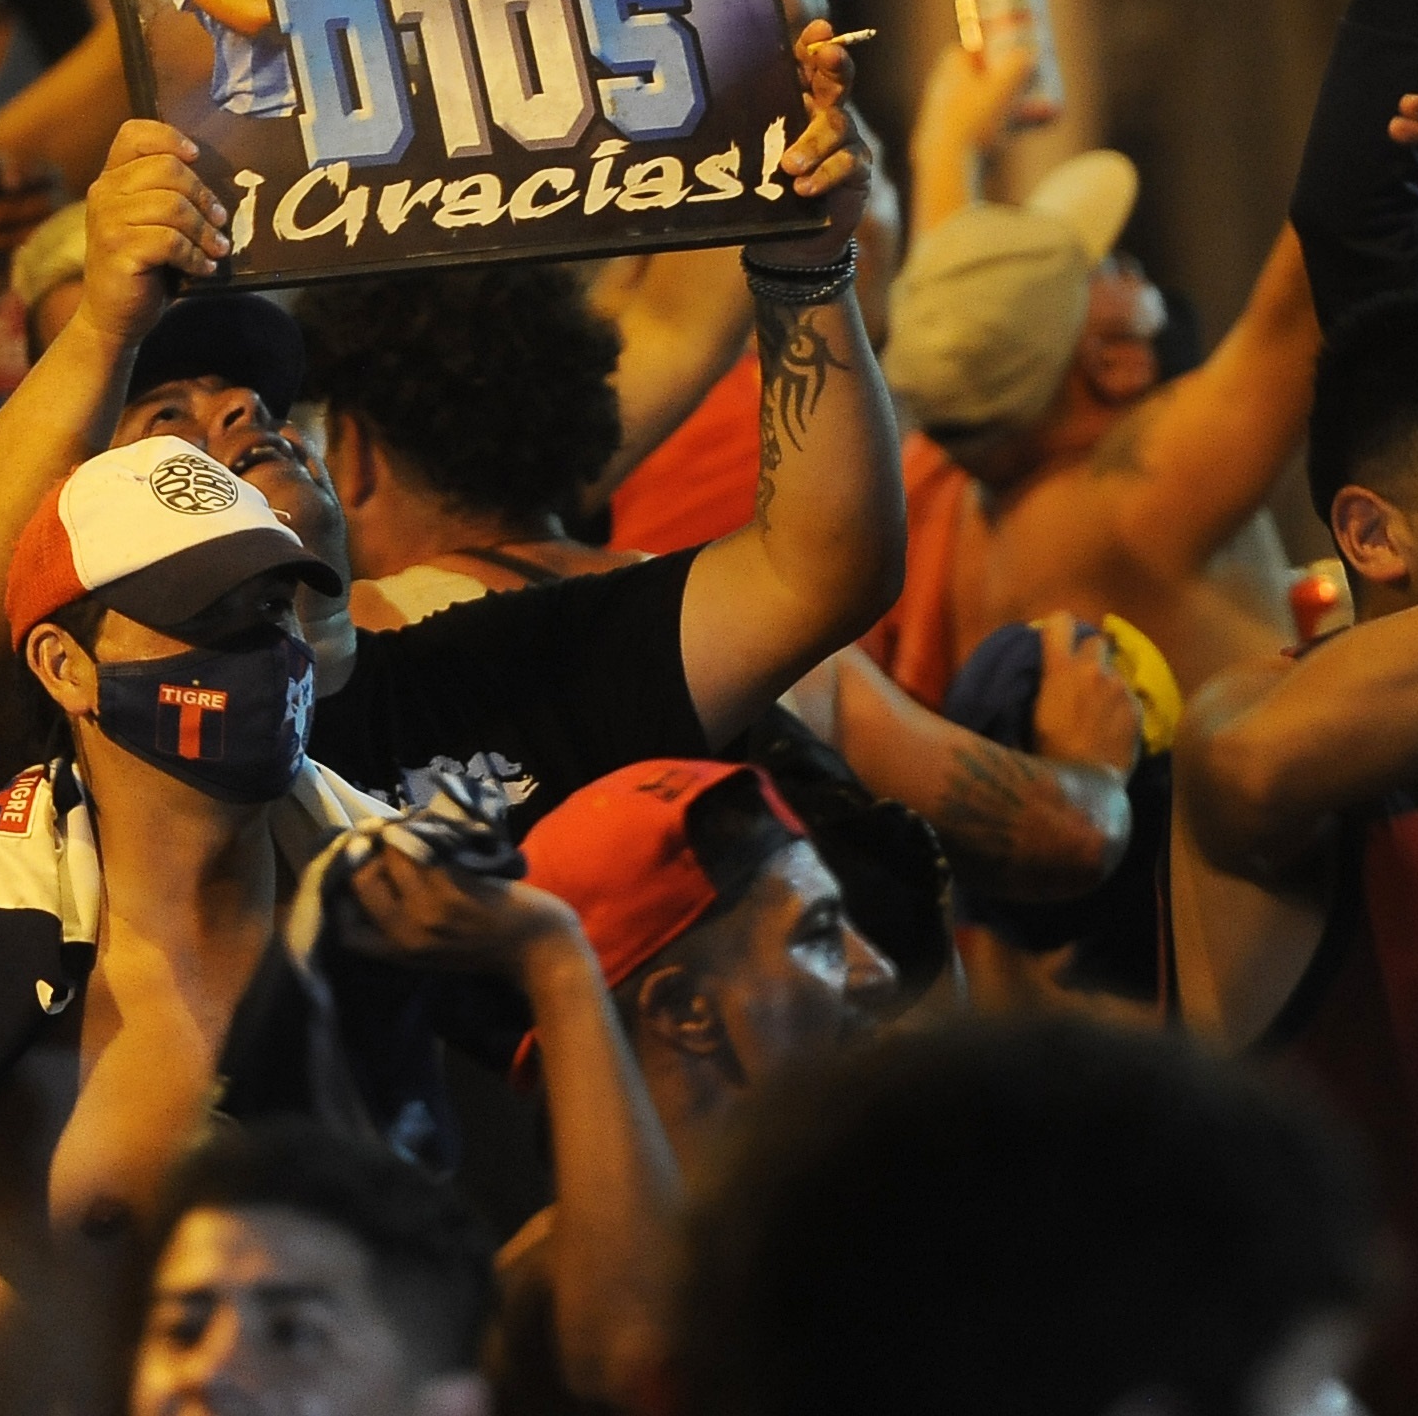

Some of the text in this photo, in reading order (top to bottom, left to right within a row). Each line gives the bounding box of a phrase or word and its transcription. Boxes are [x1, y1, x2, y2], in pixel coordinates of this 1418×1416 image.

[230, 116, 787, 256] ¡Gracias!
[161, 686, 225, 709] TIGRE
[2, 775, 40, 824] TIGRE
